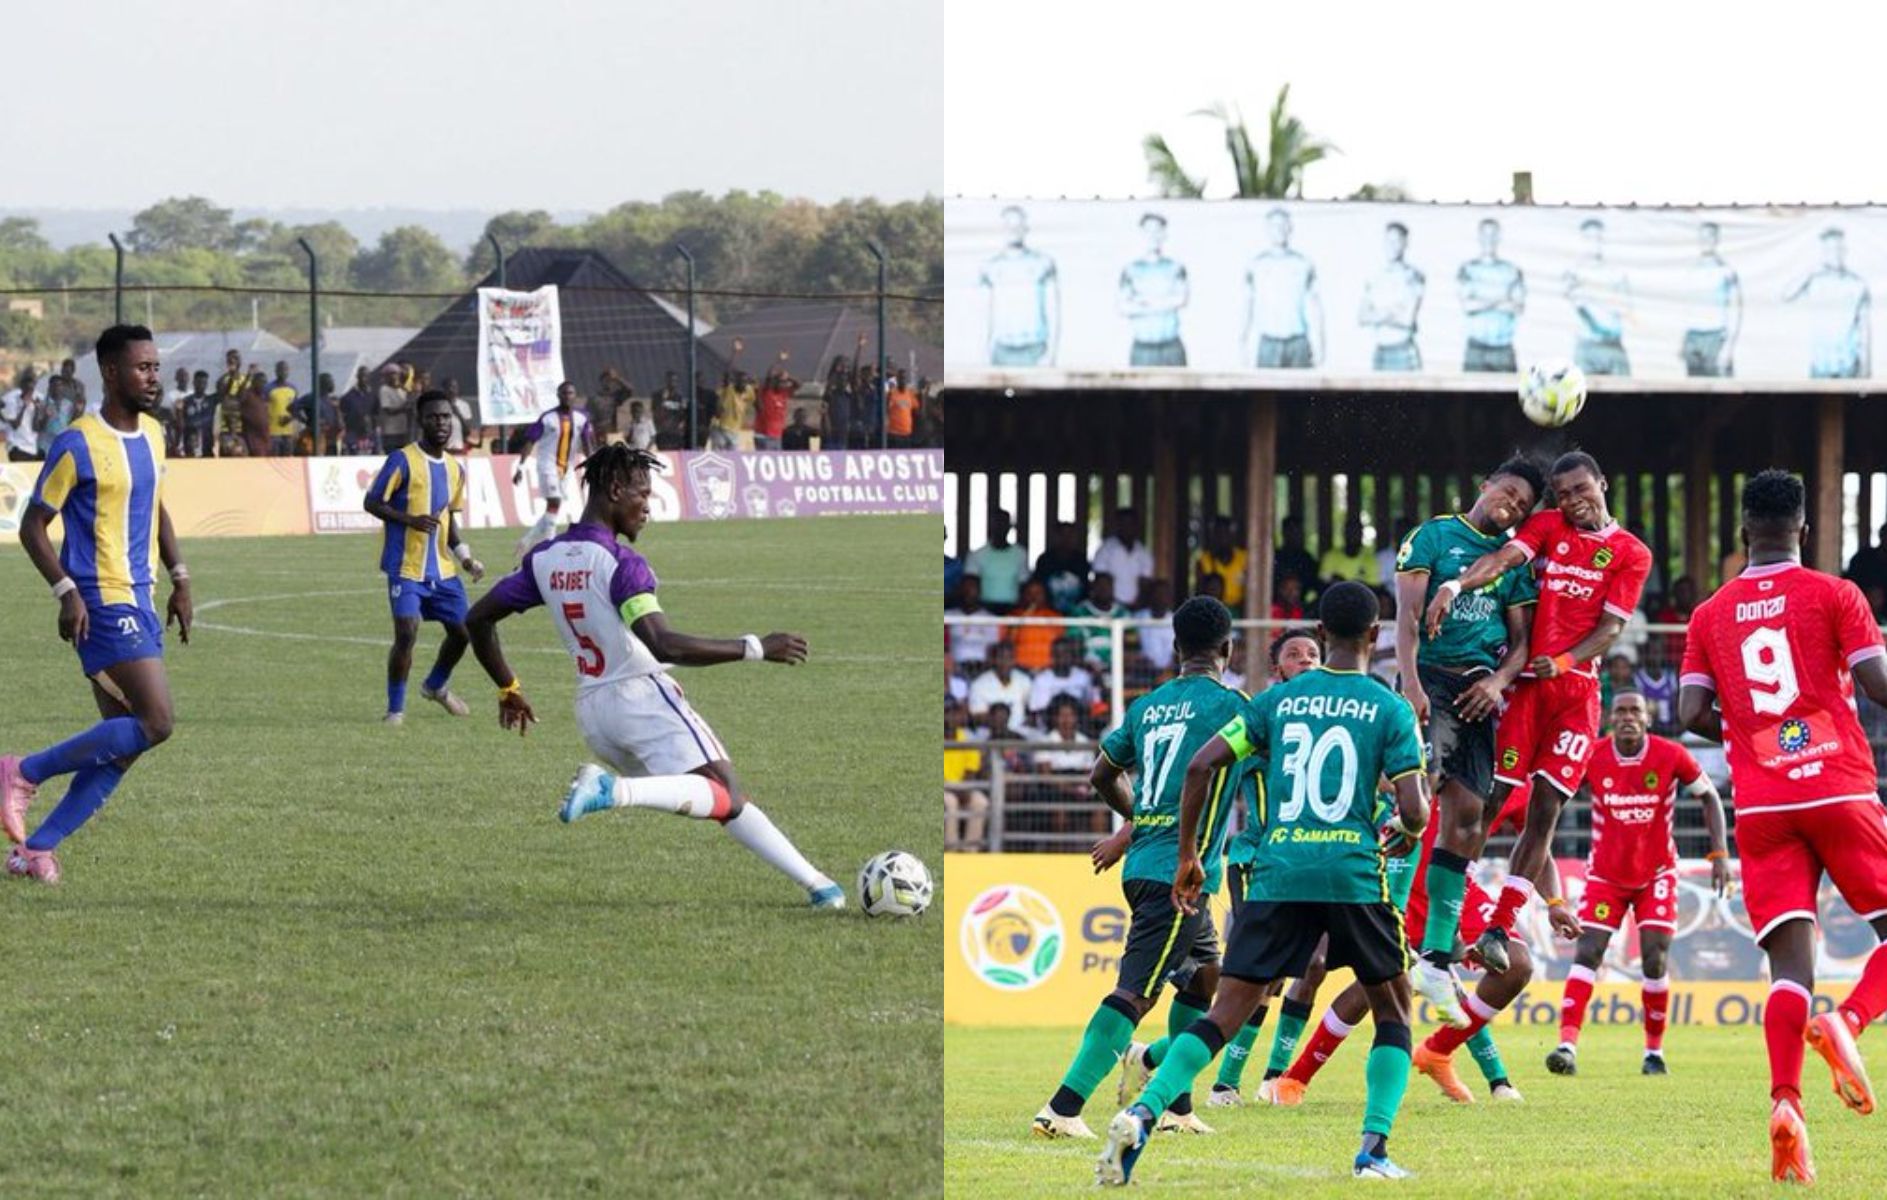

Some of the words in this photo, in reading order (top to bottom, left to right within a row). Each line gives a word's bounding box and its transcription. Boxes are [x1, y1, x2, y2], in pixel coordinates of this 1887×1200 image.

[742, 455, 833, 482] YOUNG
[794, 486, 887, 503] FOOTBALL
[893, 484, 939, 501] CLUB
[117, 615, 139, 635] 21
[562, 603, 605, 678] 5
[1741, 626, 1799, 716] 9
[1142, 700, 1195, 724] AFFUL
[1276, 695, 1378, 723] ACQUAH
[1553, 730, 1590, 762] 30
[1140, 722, 1188, 811] 17
[1278, 722, 1358, 823] 30
[1268, 827, 1289, 845] FC
[1512, 992, 1702, 1025] fotbll.
